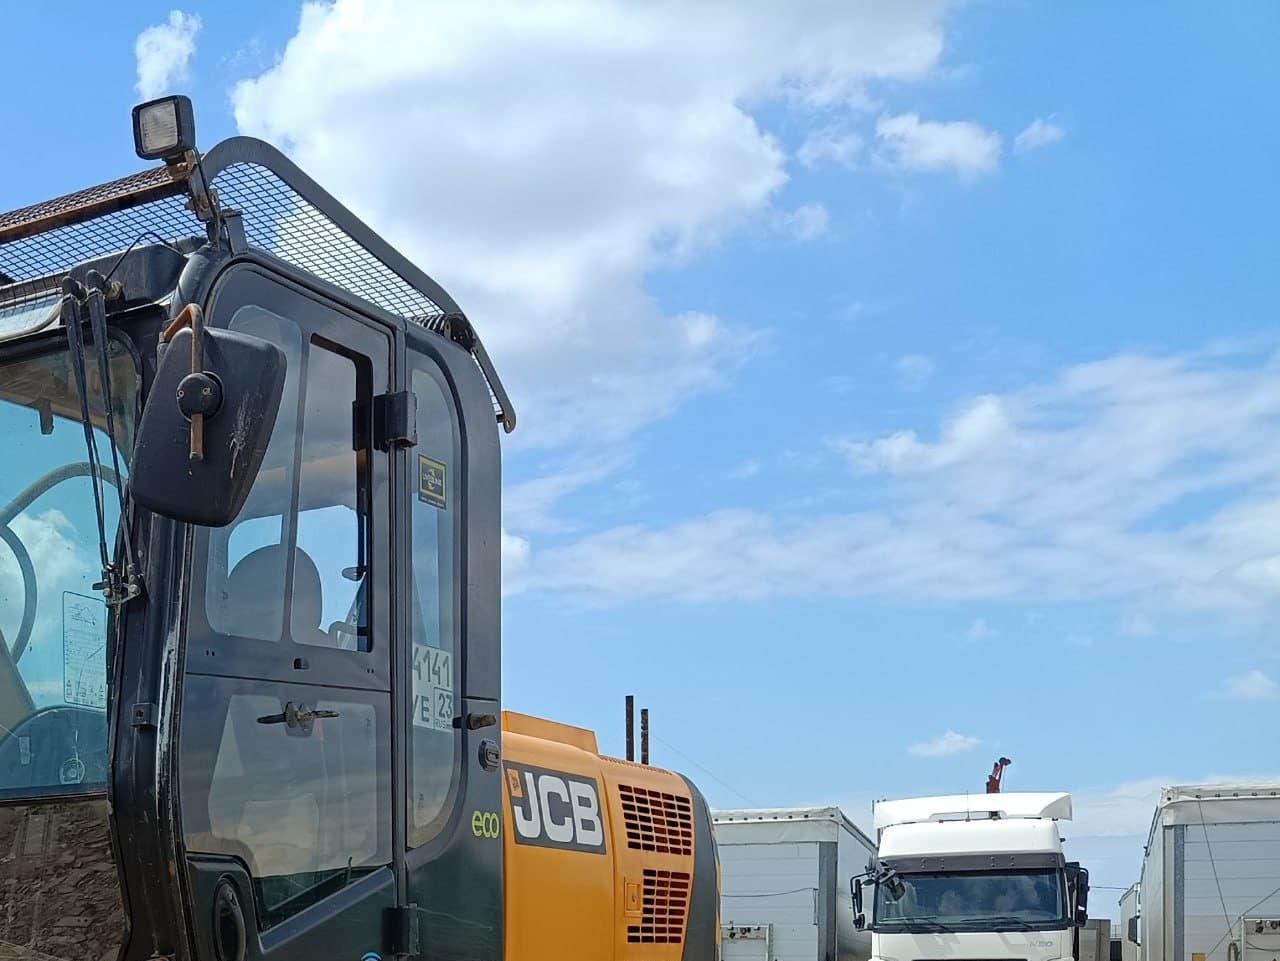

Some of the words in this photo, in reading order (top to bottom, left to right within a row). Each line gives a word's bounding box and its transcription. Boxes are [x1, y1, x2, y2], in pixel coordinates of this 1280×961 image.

[438, 693, 453, 719] 23
[513, 771, 604, 847] JCB
[471, 810, 500, 839] eco
